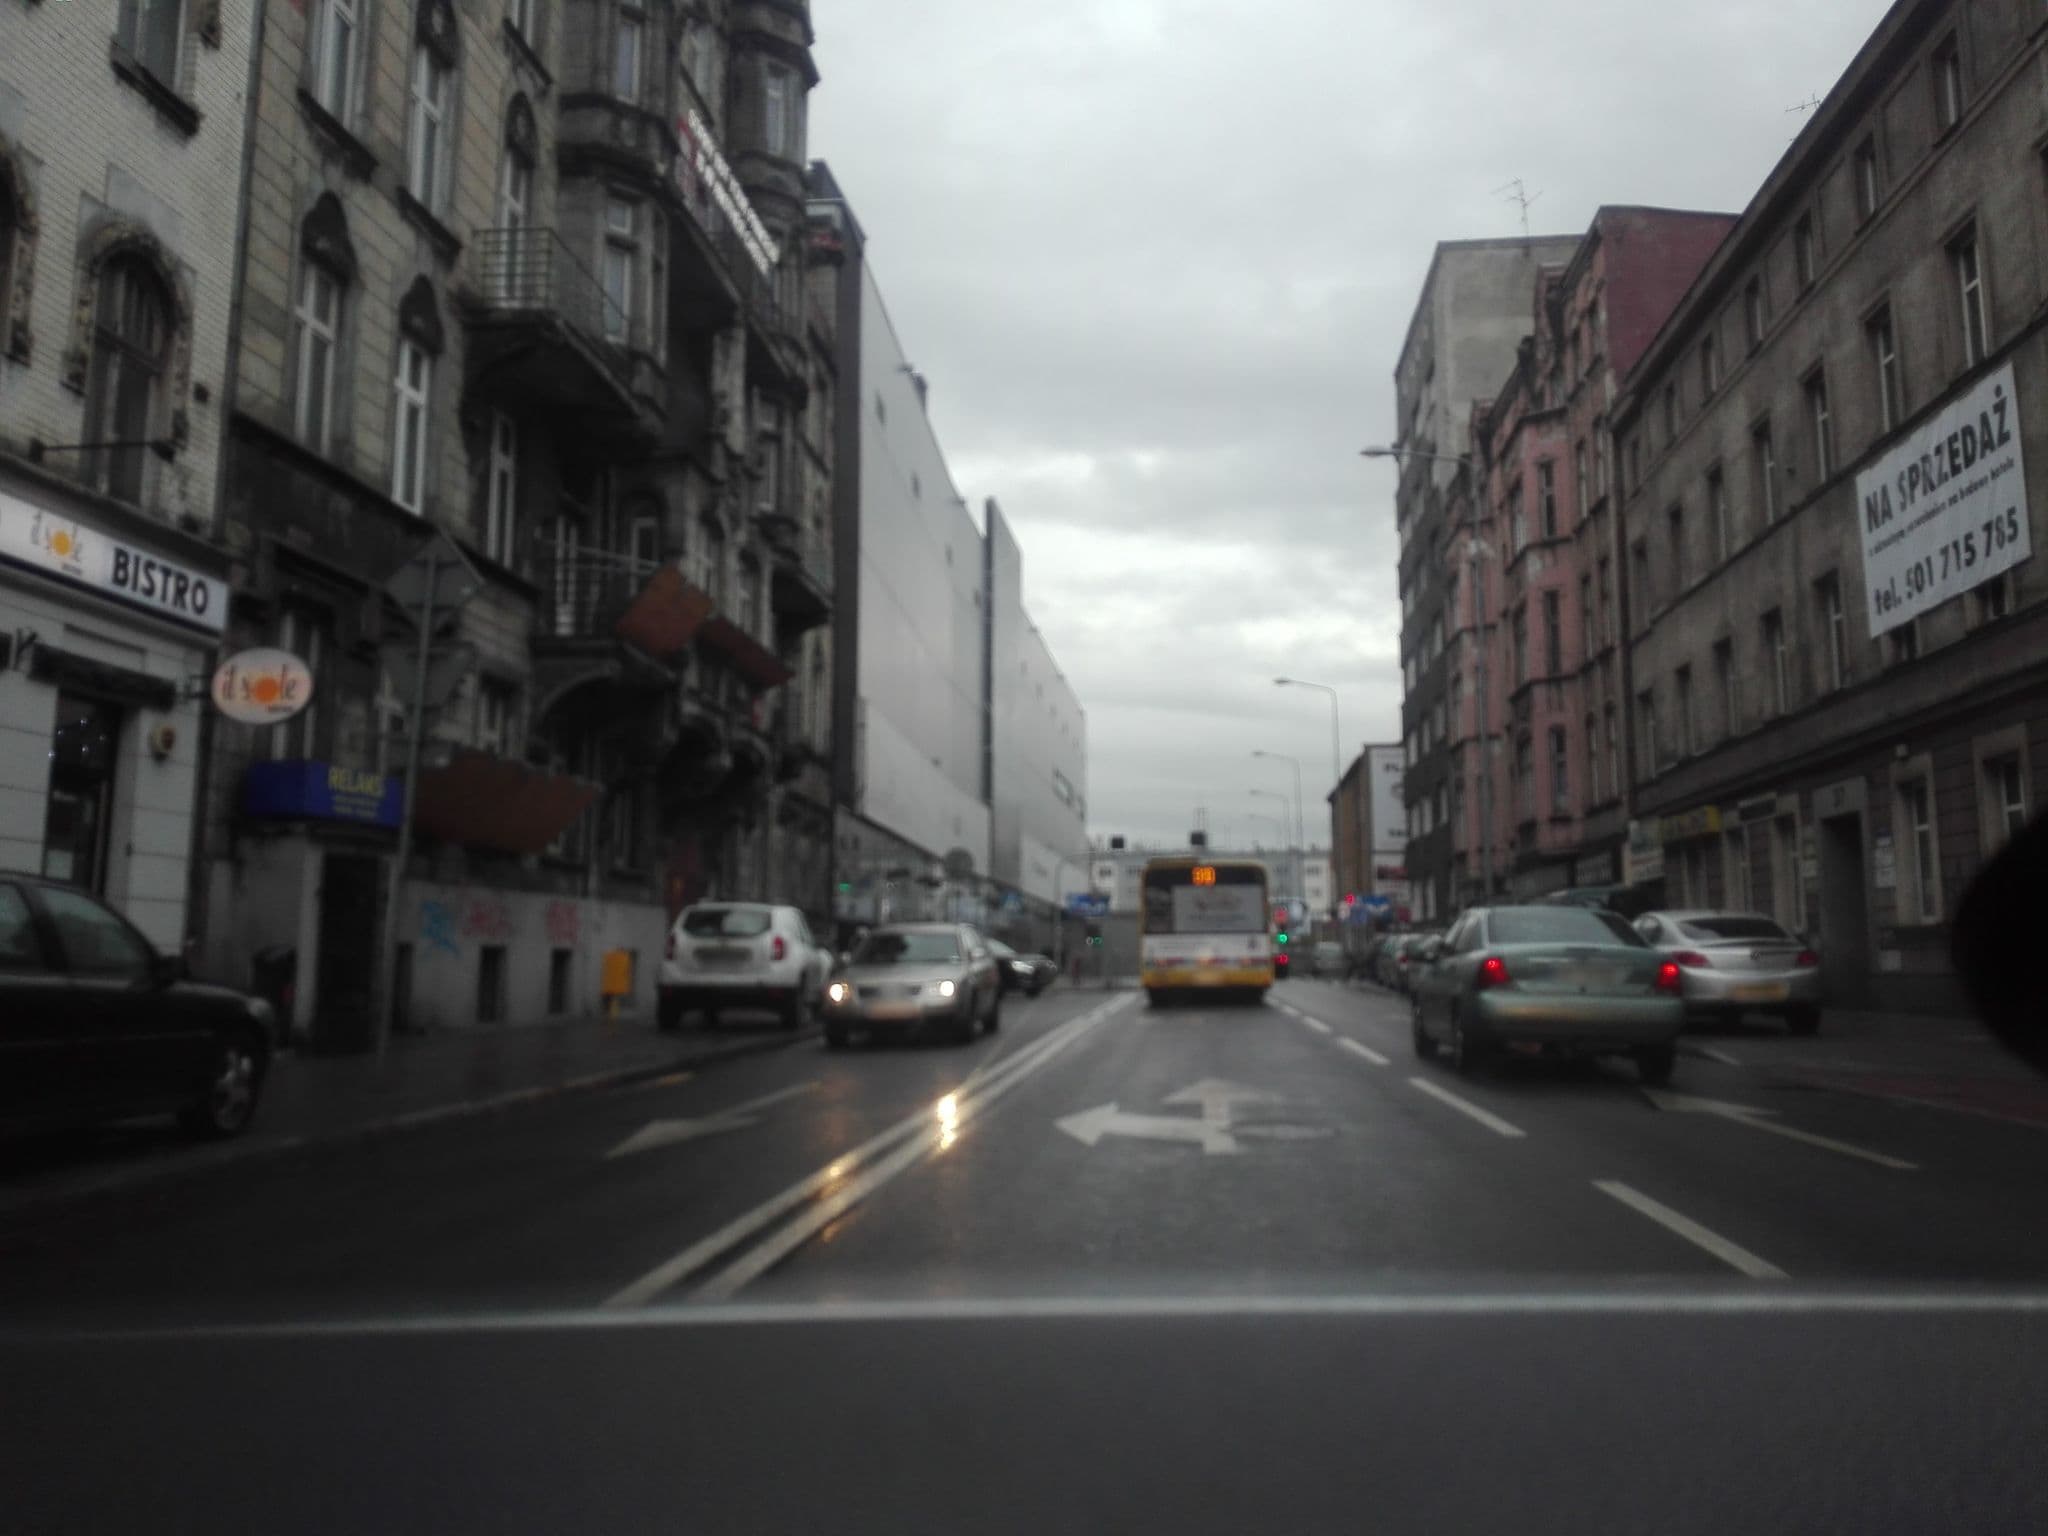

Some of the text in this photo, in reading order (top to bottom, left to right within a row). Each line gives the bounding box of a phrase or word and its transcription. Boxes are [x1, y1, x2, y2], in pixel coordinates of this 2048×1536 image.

[1865, 484, 1893, 534] NA
[1897, 384, 2011, 512] SPRZEDAŻ
[111, 546, 210, 616] BISTRO
[1874, 577, 1903, 617] tel.
[1905, 555, 1935, 600] 501
[1940, 530, 1977, 580] 715
[1982, 508, 2019, 558] 785
